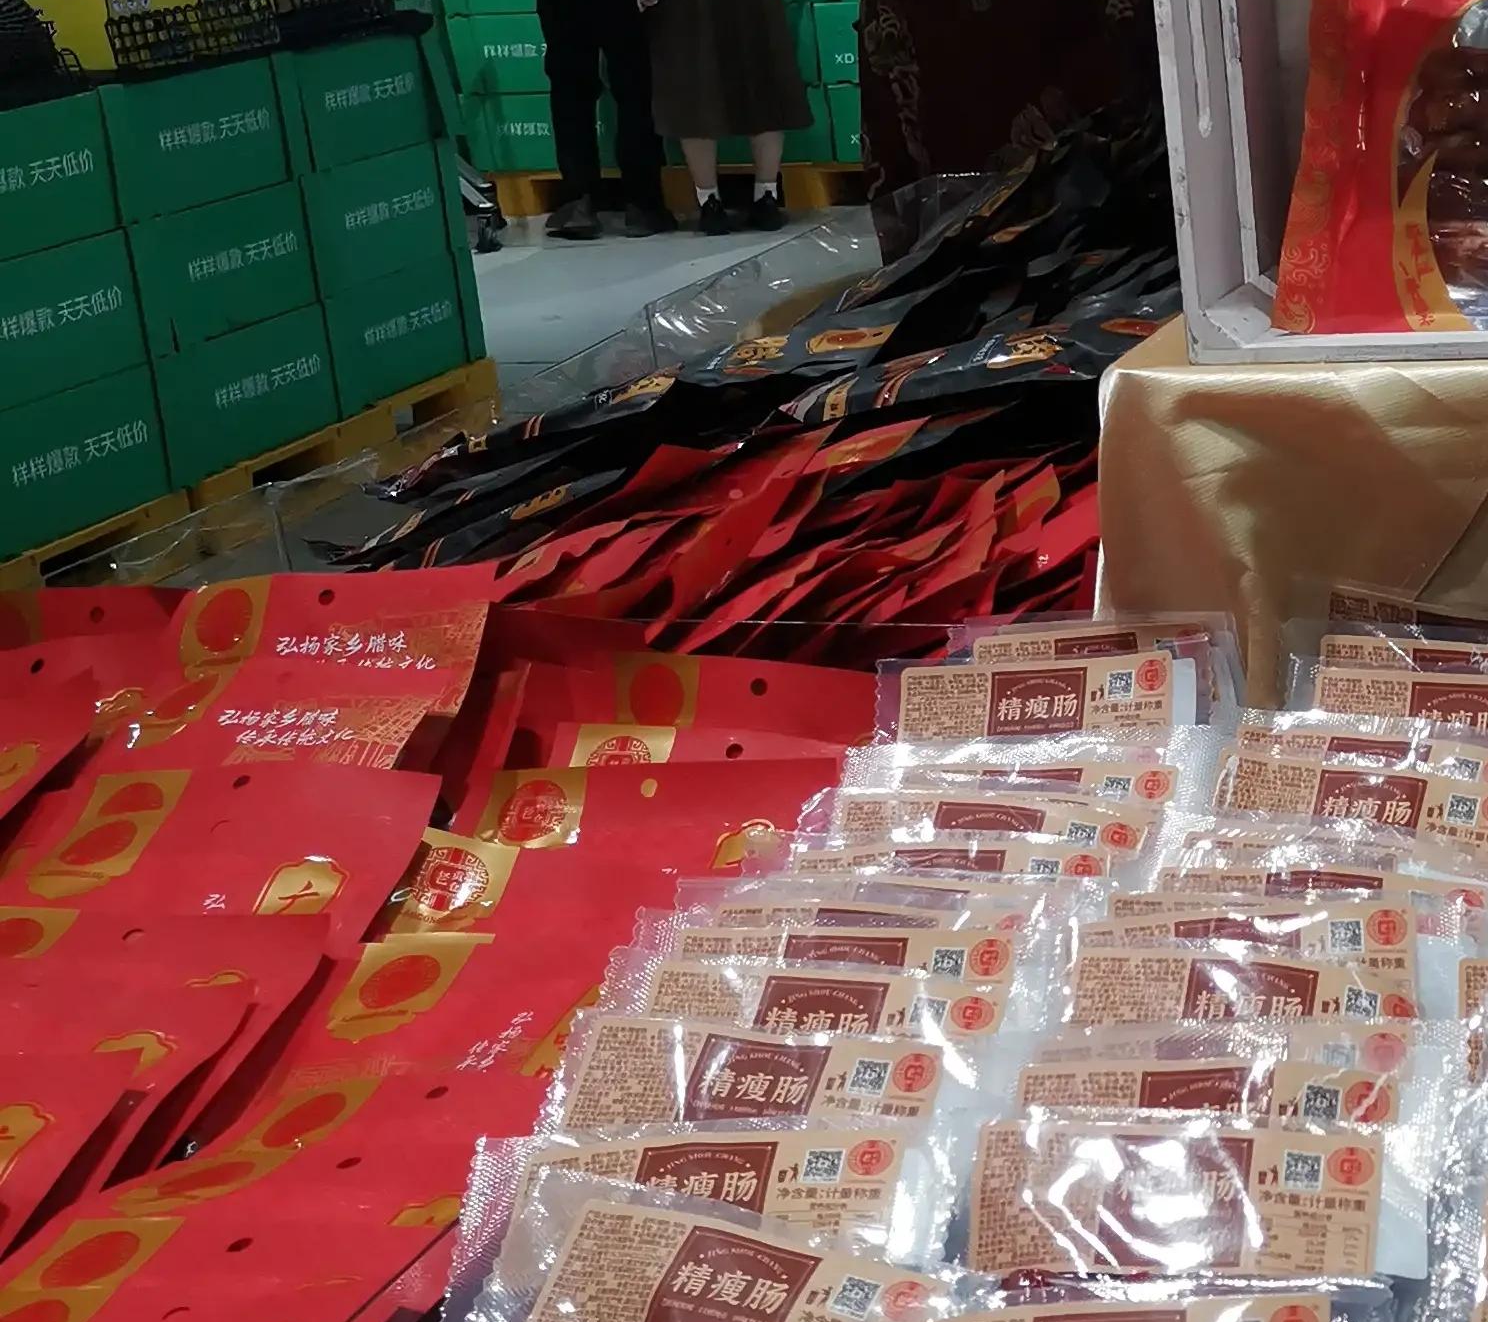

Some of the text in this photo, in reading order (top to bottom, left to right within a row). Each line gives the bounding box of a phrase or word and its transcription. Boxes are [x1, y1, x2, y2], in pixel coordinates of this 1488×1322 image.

[276, 631, 408, 657] 弘扬家乡腊味
[996, 692, 1079, 722] 精瘦肠
[1323, 794, 1413, 824] 精瘦肠
[766, 1006, 871, 1035] 精瘦肠
[698, 1070, 811, 1107] 精瘦肠
[670, 1258, 791, 1315] 精瘦肠
